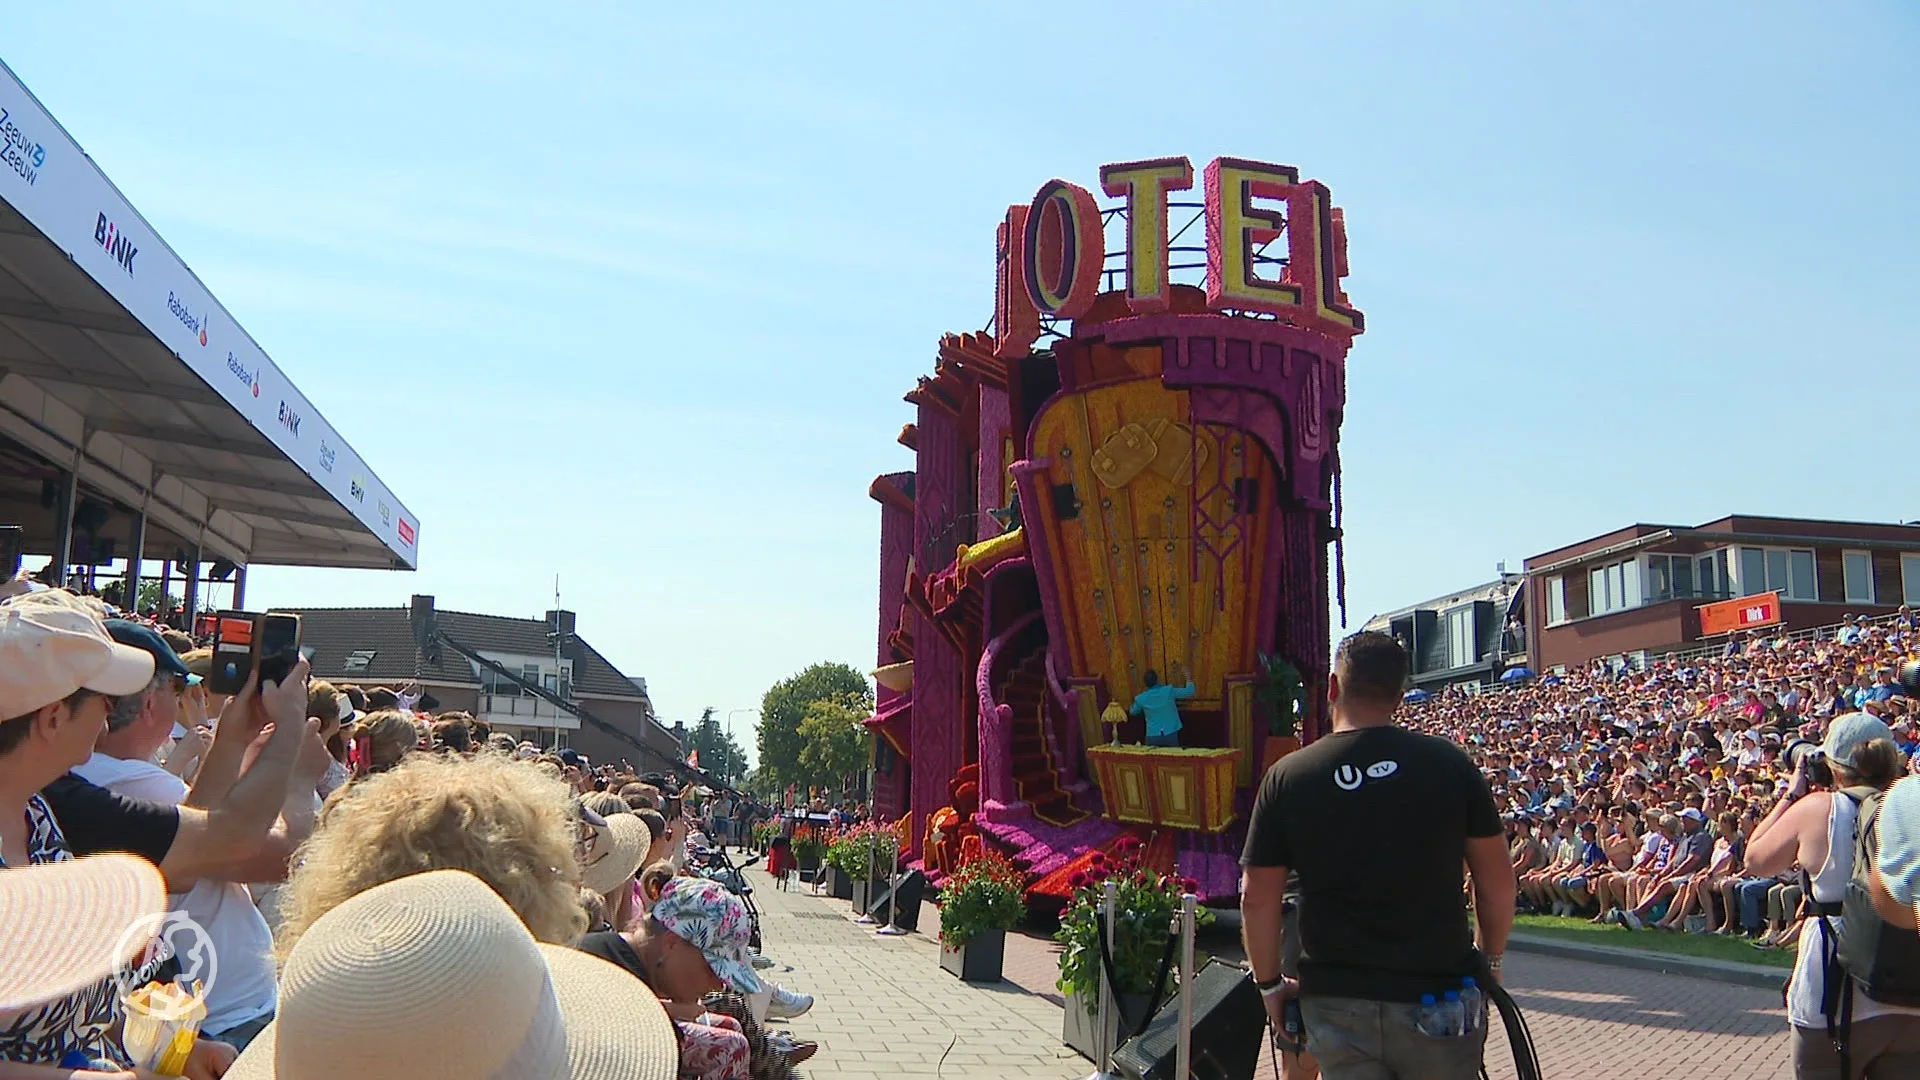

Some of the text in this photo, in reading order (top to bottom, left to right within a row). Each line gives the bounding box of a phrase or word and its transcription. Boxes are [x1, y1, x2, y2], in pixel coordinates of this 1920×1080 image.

[0, 108, 34, 158] Zeeuw
[0, 137, 37, 186] Zeeuw
[167, 291, 199, 336] Rabobank
[227, 351, 252, 388] Rabobank
[1746, 606, 1764, 621] Dirk
[1373, 764, 1390, 774] TV
